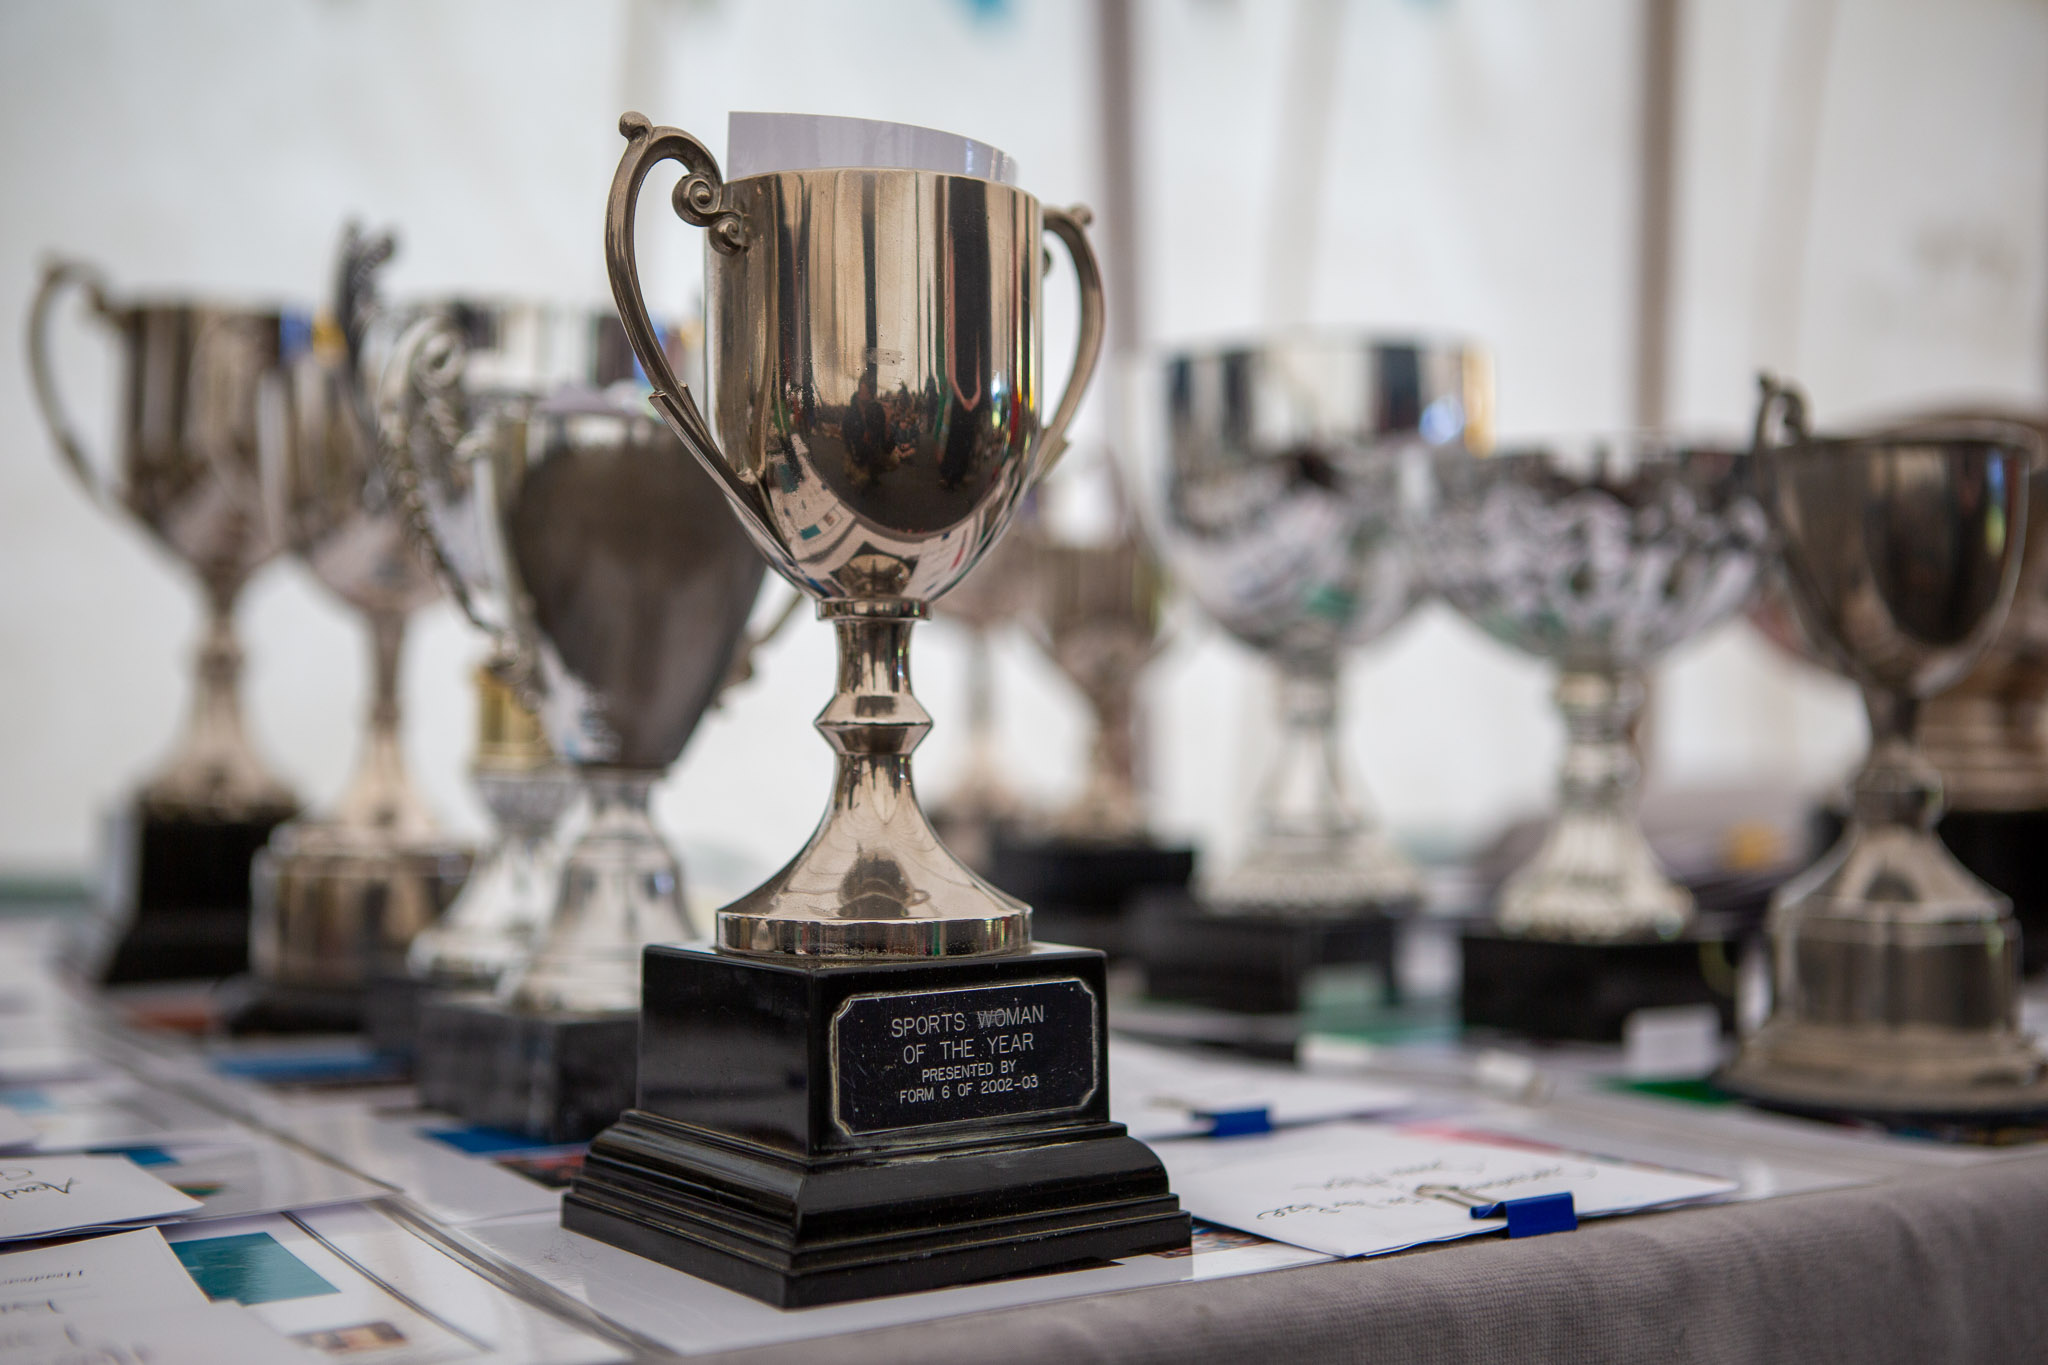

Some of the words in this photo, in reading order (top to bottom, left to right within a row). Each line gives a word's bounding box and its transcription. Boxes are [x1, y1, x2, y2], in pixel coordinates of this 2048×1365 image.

[891, 1013, 966, 1038] SPORTS
[978, 1005, 1044, 1028] WOMAN
[903, 1044, 926, 1064] OF
[940, 1039, 975, 1059] THE
[987, 1033, 1034, 1054] YEAR
[922, 1062, 993, 1083] PRESENTED
[1001, 1060, 1016, 1073] BY
[900, 1086, 934, 1104] FORM
[942, 1086, 950, 1099] 6
[958, 1083, 972, 1097] OF
[981, 1075, 1039, 1095] 2002-03
